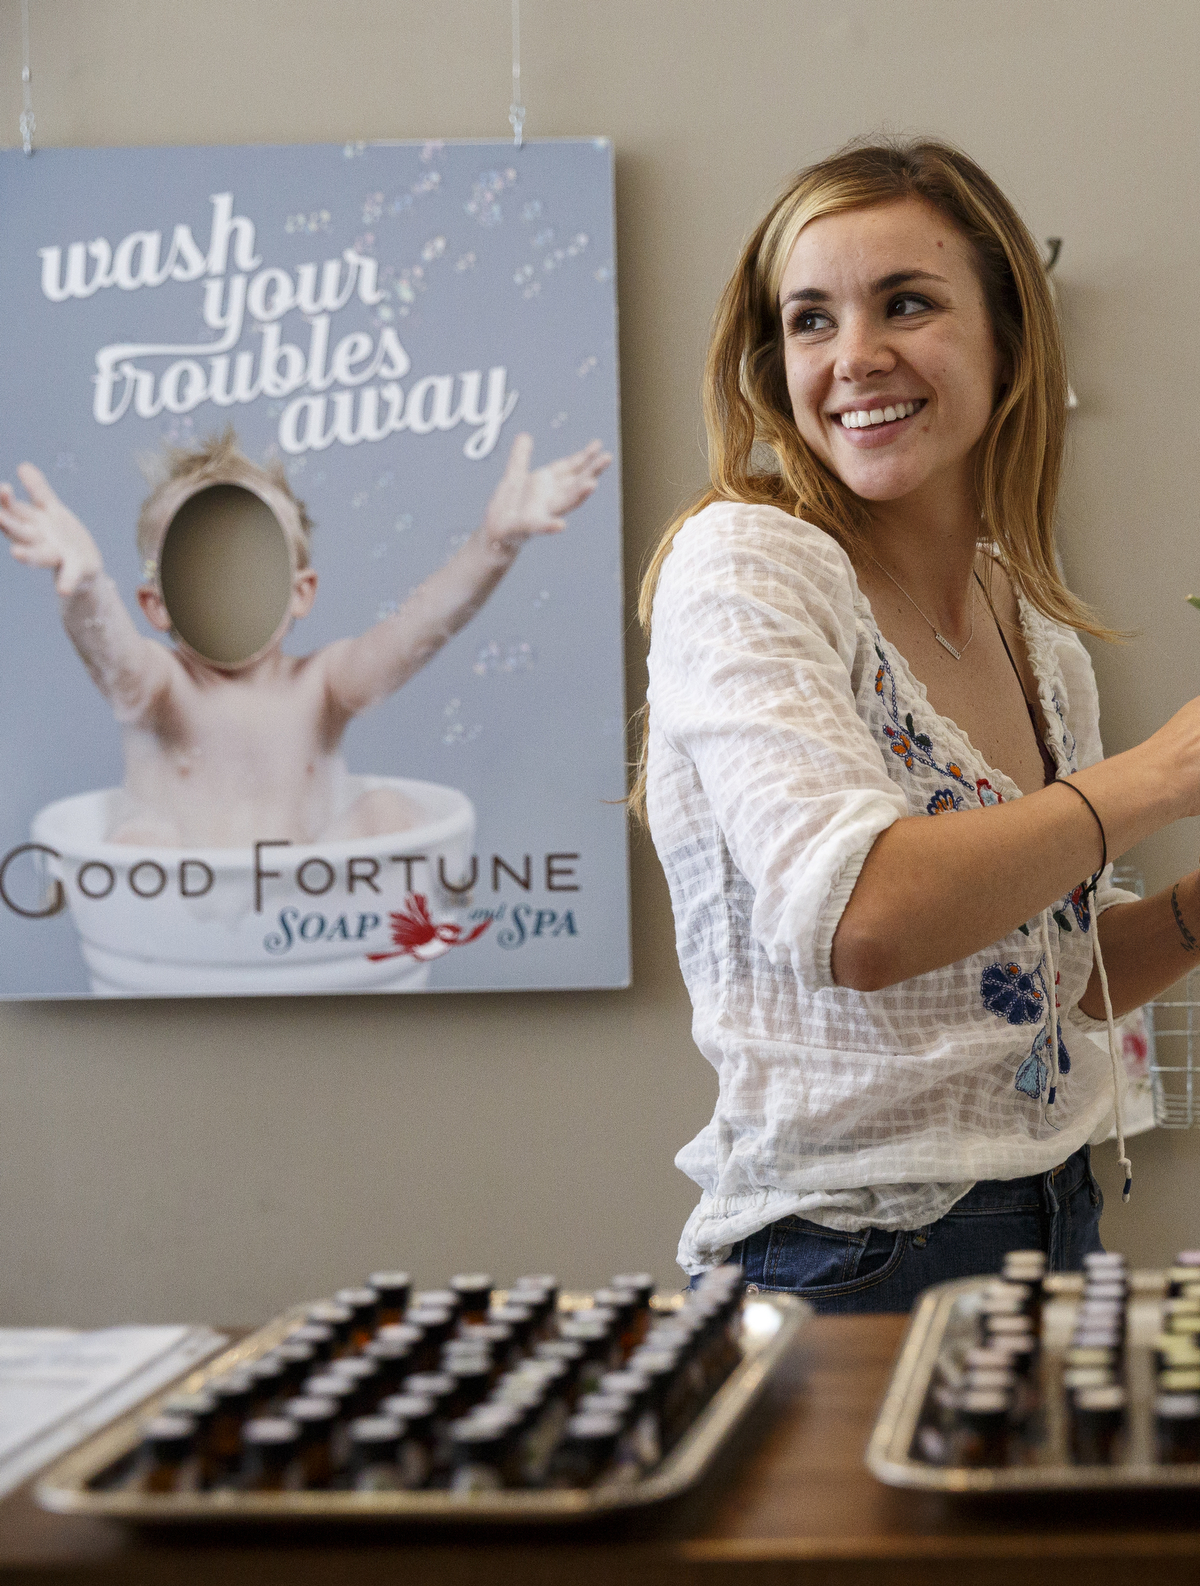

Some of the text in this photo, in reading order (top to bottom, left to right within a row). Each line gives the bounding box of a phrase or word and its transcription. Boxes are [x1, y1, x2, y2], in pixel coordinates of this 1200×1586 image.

[38, 191, 262, 302] wash
[199, 247, 386, 355] your
[92, 314, 411, 425] troubles
[278, 365, 519, 461] away
[0, 840, 580, 919] GOOD FORTUNE
[263, 907, 381, 954] SOAP
[499, 903, 579, 950] SPA
